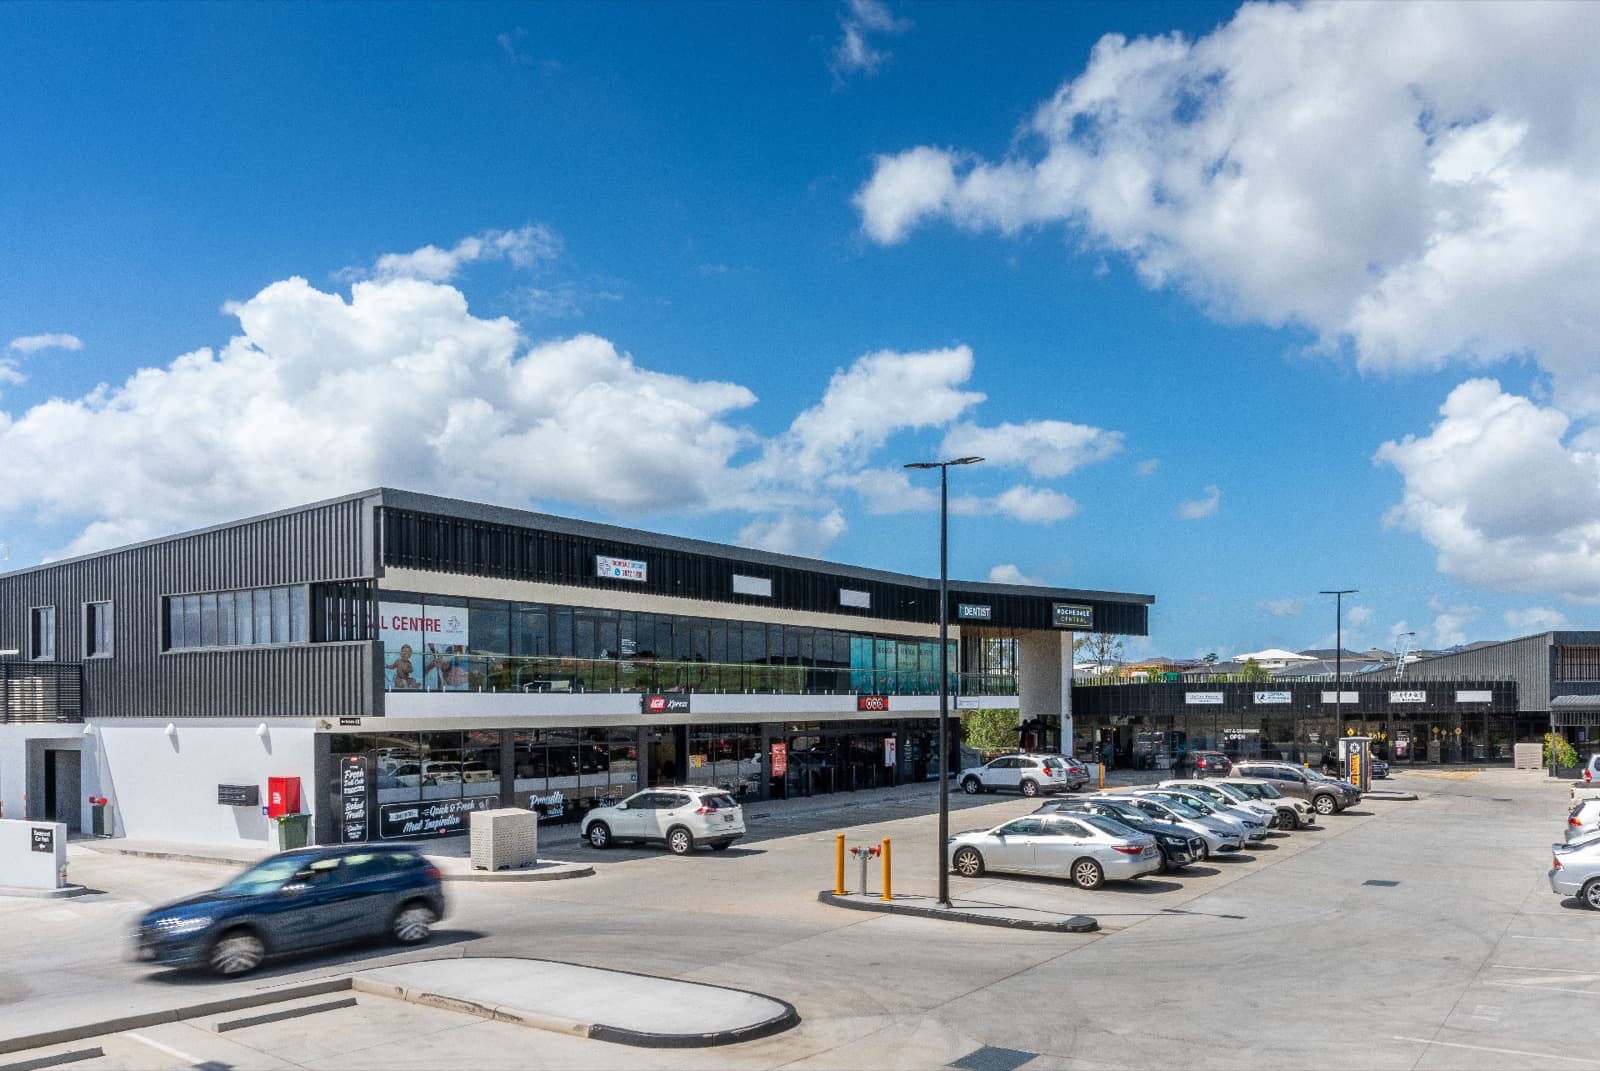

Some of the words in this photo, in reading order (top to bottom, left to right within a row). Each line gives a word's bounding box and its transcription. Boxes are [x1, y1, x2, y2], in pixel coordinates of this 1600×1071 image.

[964, 606, 990, 617] DENTIST
[1056, 608, 1090, 616] ROCHEDALE
[392, 615, 441, 632] CENTRE
[651, 698, 664, 708] IGA
